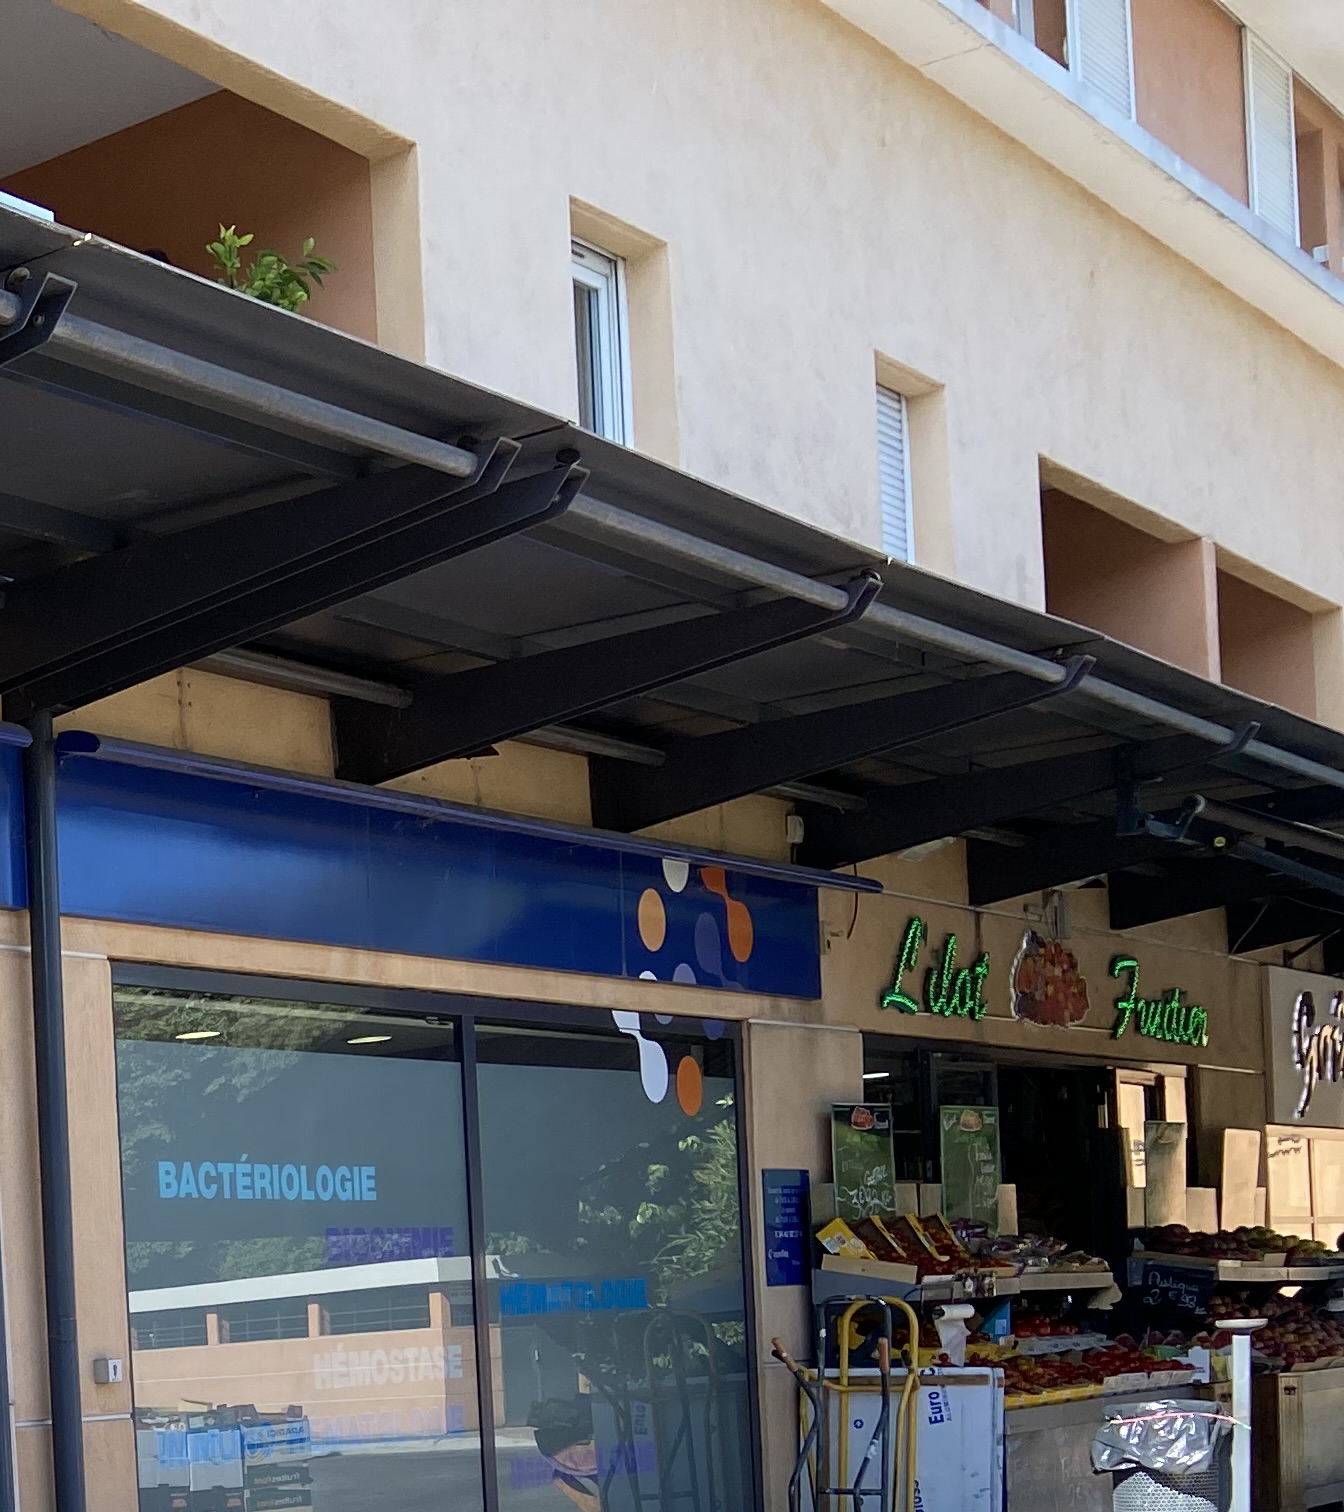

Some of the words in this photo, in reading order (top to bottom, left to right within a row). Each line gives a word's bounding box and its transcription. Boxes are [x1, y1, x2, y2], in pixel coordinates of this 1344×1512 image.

[158, 1155, 377, 1202] BACTÉRIOLOGIE
[314, 1342, 463, 1390] HÉMOSTASE
[928, 1391, 946, 1426] Euro
